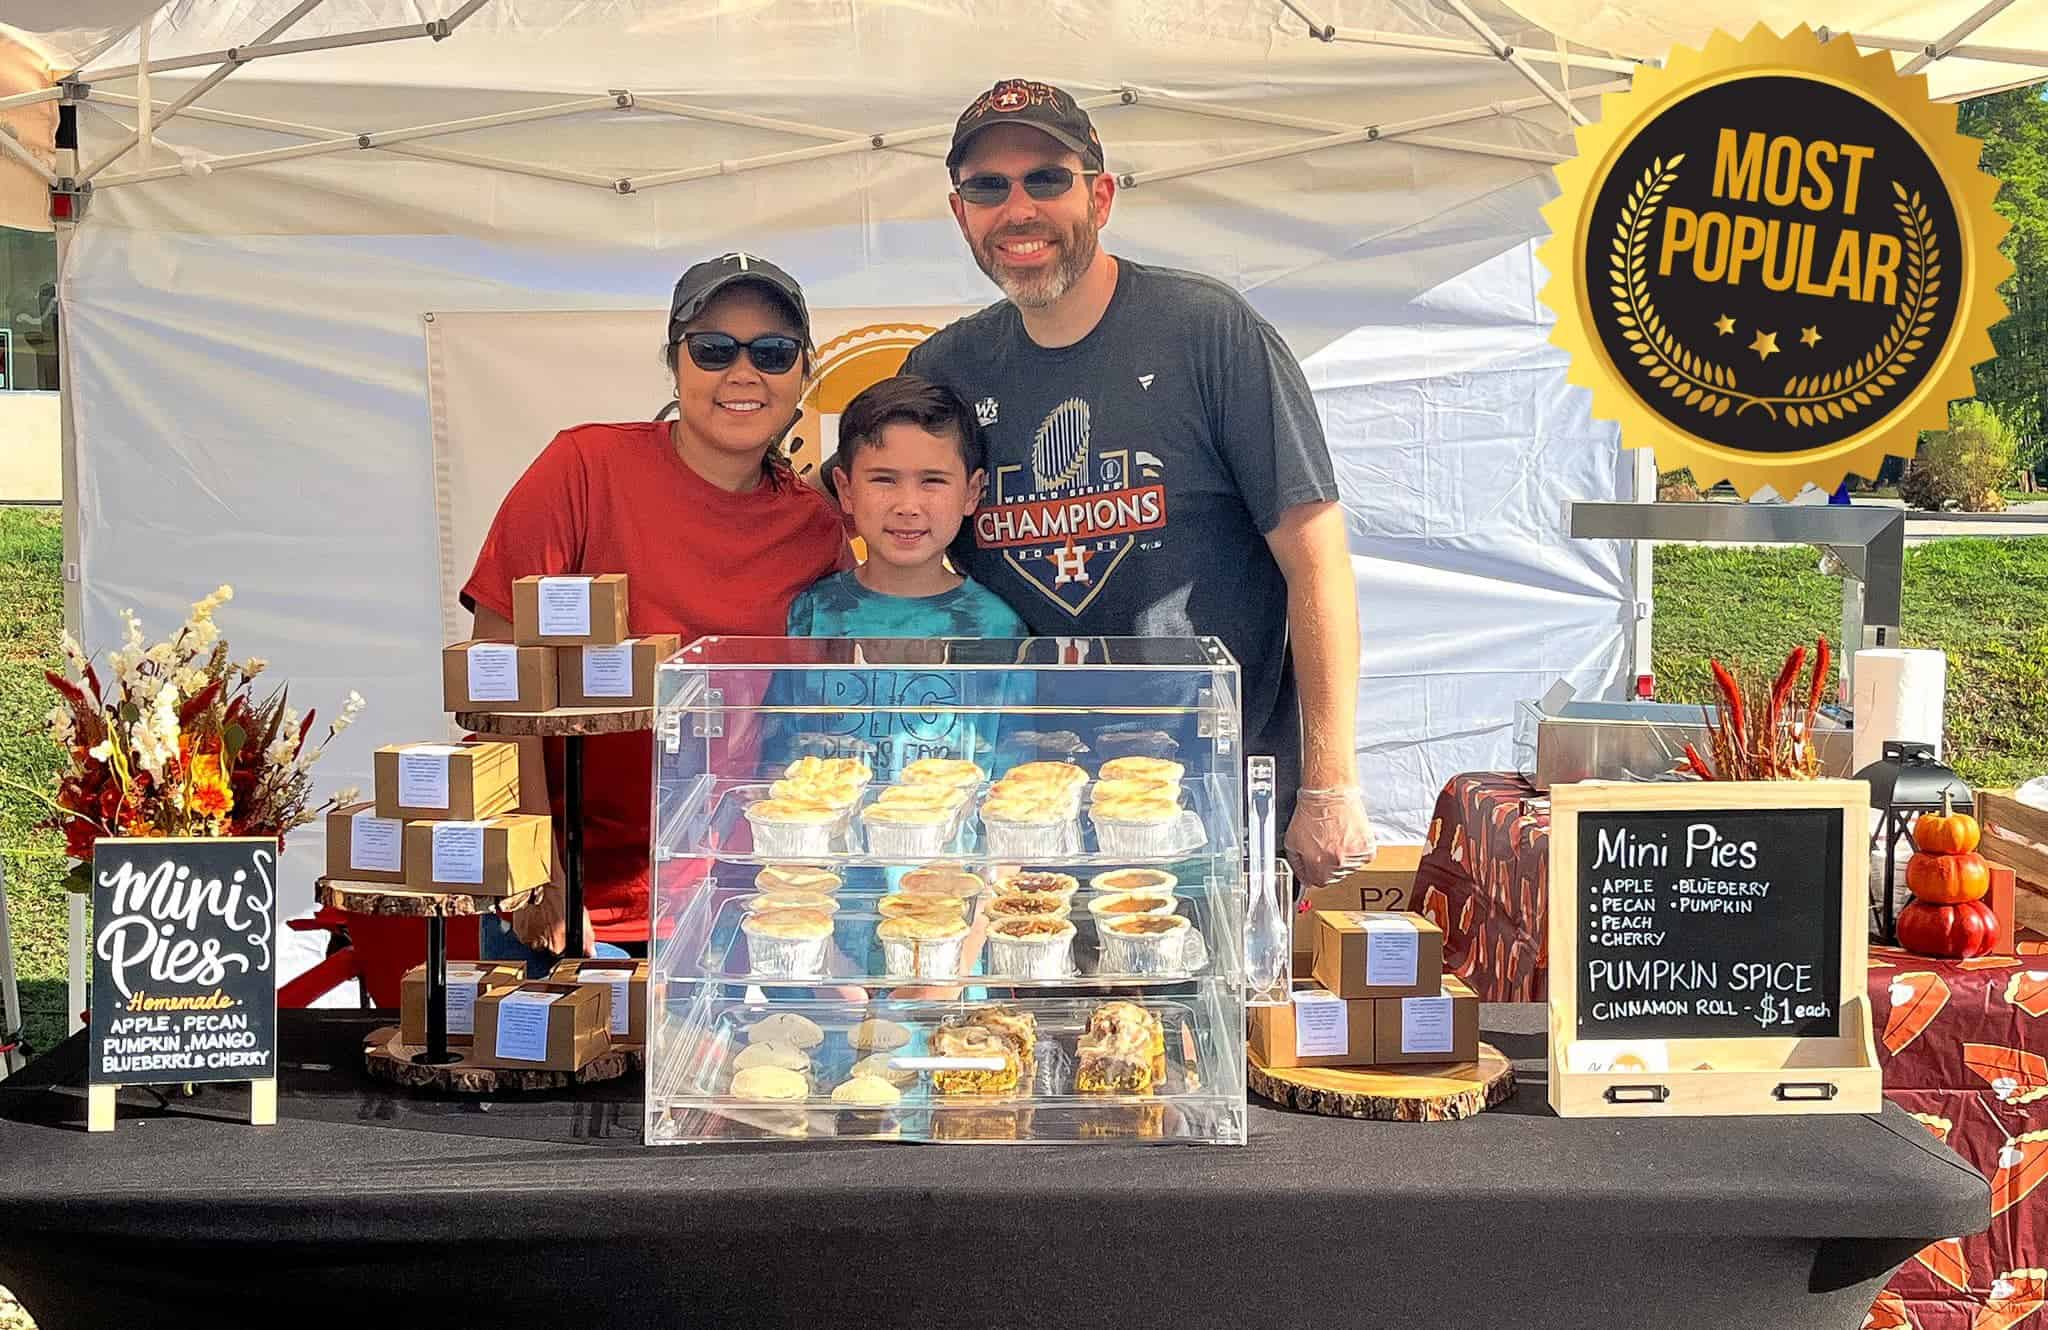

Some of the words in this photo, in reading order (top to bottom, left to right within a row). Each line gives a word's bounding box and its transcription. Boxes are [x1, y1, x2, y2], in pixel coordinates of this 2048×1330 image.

[1004, 491, 1058, 504] WORLD
[977, 491, 1160, 542] CHAMPIONS
[1054, 545, 1090, 584] H
[822, 671, 959, 742] BIG
[1592, 828, 1668, 870] Mini
[1686, 823, 1758, 870] Pies
[1360, 887, 1405, 912] P2
[1602, 879, 1655, 895] APPLE
[1678, 878, 1770, 898] BLUEBERRY
[1602, 898, 1656, 913] PECAN
[1679, 899, 1753, 914] PUMPKIN
[1601, 916, 1652, 930] PEACH
[1601, 931, 1666, 947] CHERRY
[96, 915, 250, 999] Pies
[1589, 959, 1717, 993] PUMPKIN
[1728, 962, 1813, 993] SPICE
[126, 988, 235, 1012] Homemade
[1592, 998, 1688, 1021] CINNAMON
[1696, 999, 1739, 1017] ROLL
[183, 1013, 248, 1032] PECAN
[206, 1050, 270, 1070] CHERRY
